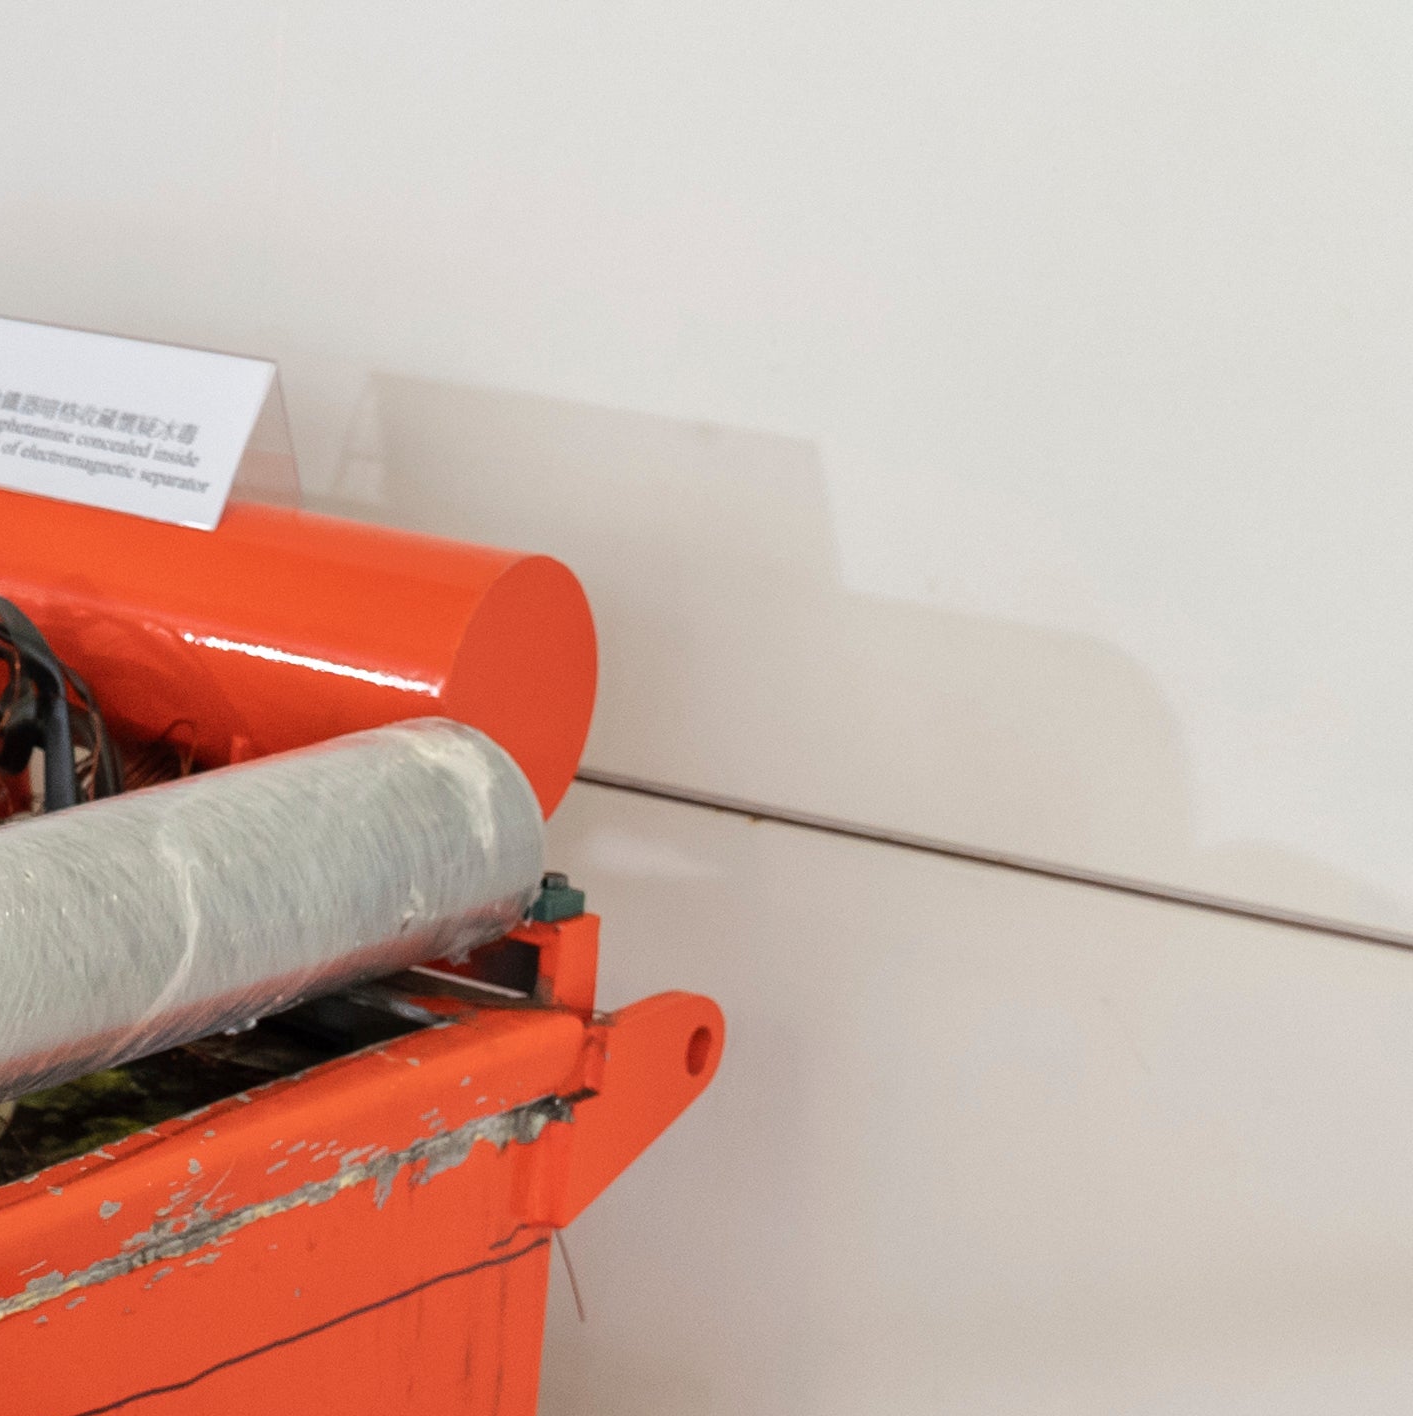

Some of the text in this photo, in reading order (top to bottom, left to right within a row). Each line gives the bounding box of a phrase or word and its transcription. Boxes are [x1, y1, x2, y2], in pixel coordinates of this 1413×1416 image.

[20, 443, 137, 478] electromagnetic
[139, 470, 211, 494] separator
[76, 434, 152, 459] concealed
[152, 448, 200, 468] inside
